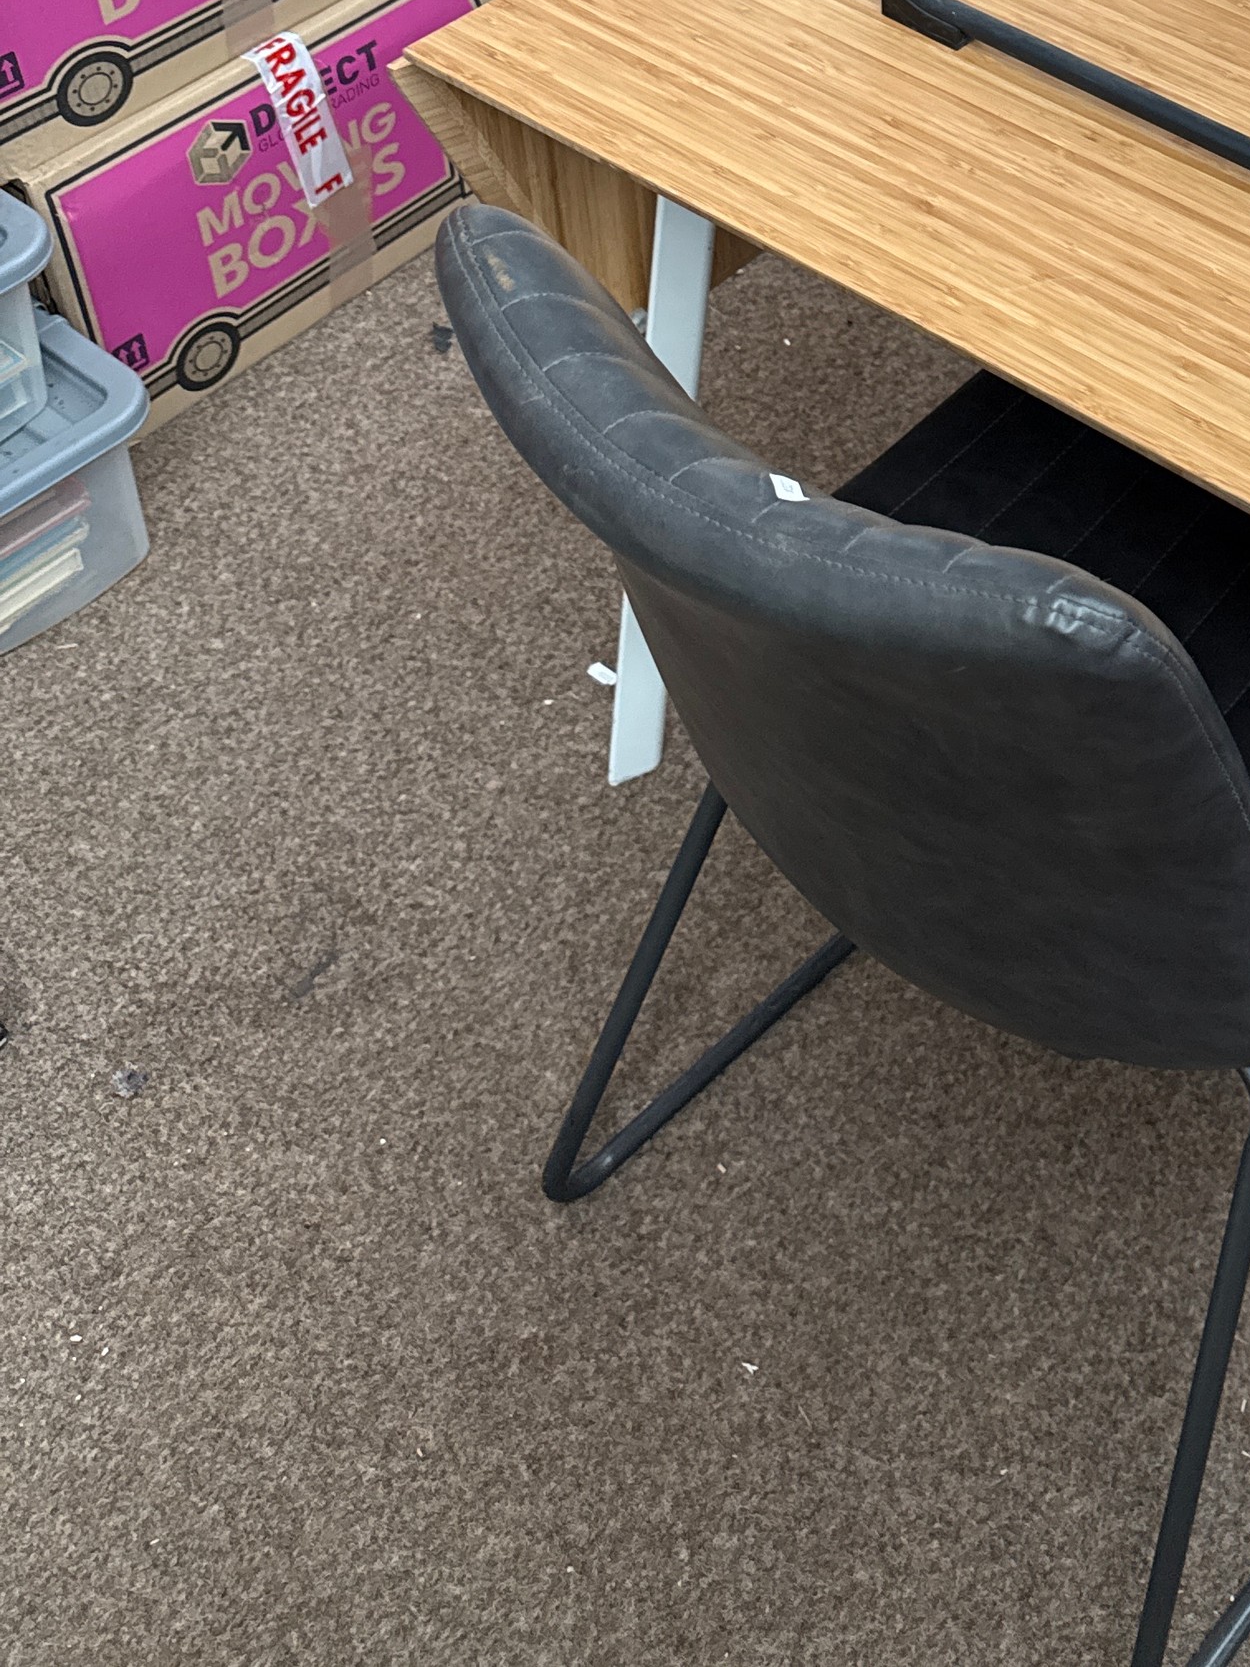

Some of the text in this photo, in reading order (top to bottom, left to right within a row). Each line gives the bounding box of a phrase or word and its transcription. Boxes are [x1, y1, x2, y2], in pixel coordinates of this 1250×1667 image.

[249, 40, 378, 138] DECT
[256, 37, 328, 155] FRAGILE
[207, 142, 406, 300] BOXS
